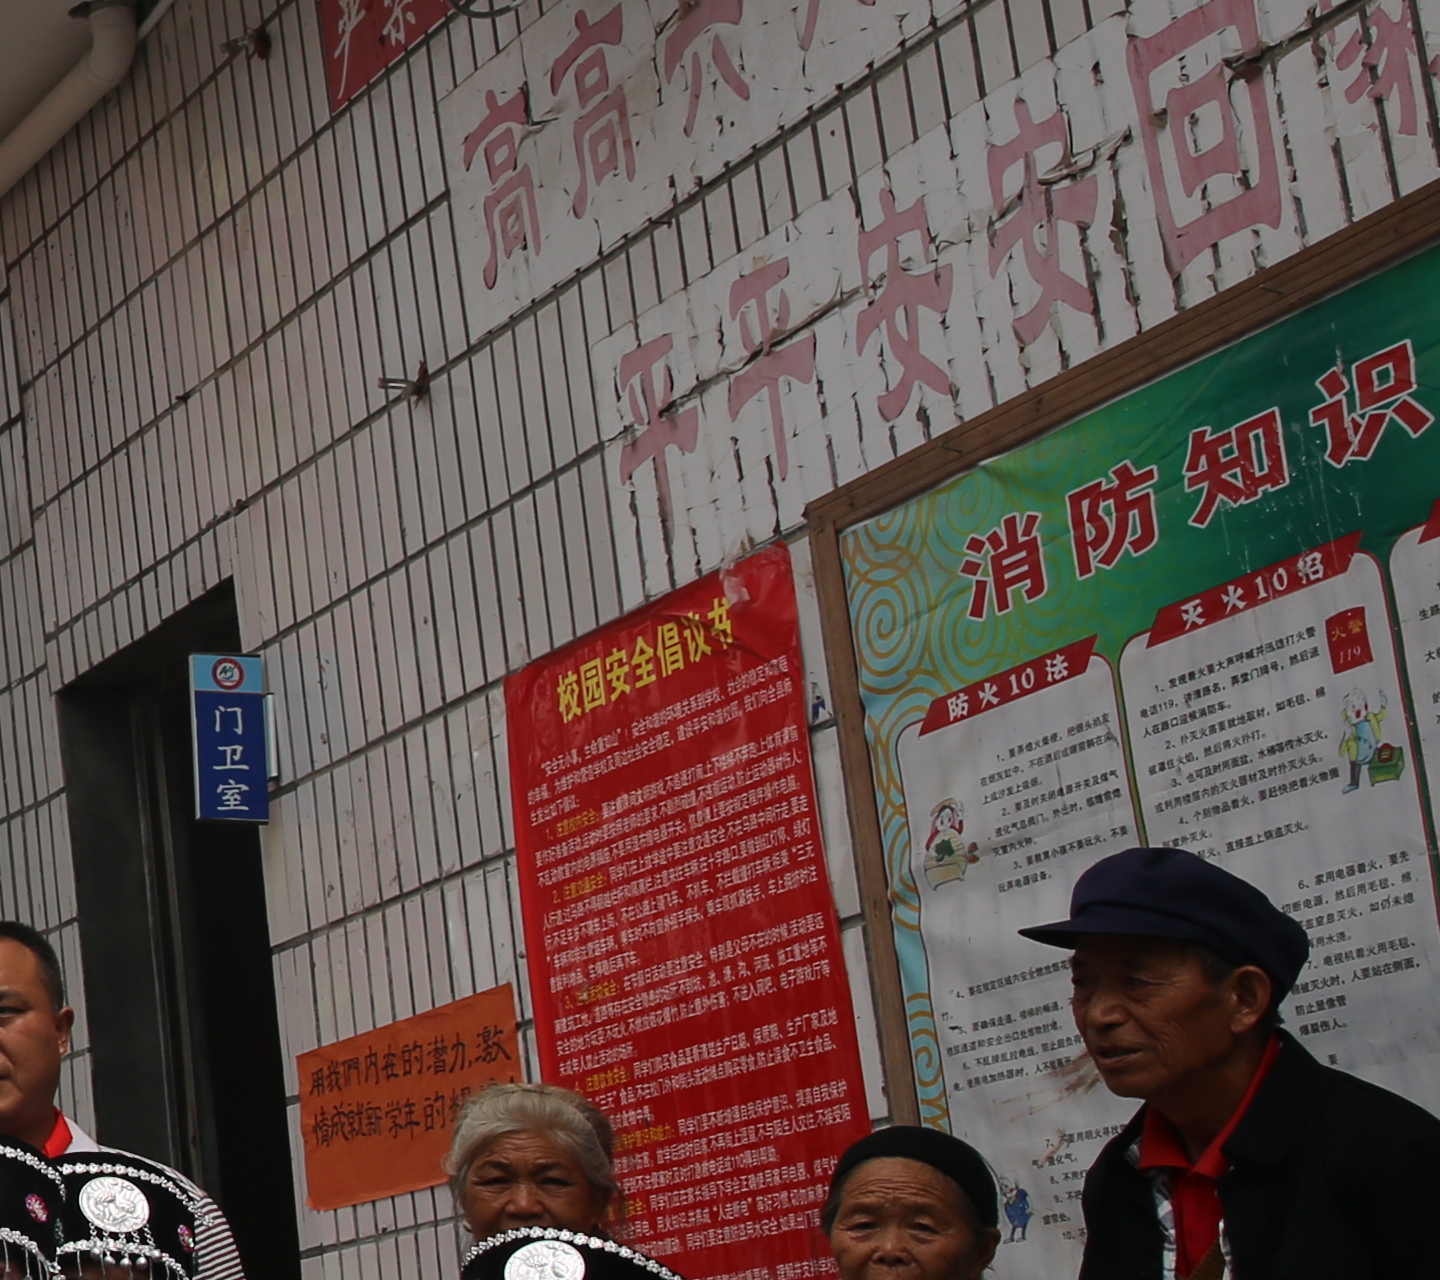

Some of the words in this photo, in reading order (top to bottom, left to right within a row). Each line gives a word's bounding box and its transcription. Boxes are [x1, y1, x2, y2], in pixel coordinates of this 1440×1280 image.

[959, 339, 1435, 621] 消防知识
[1180, 551, 1326, 632] 灭火10招
[557, 595, 731, 721] 校园安全倡议书
[946, 653, 1071, 723] 防火10法
[1338, 644, 1363, 664] 119
[212, 705, 251, 811] 门卫室
